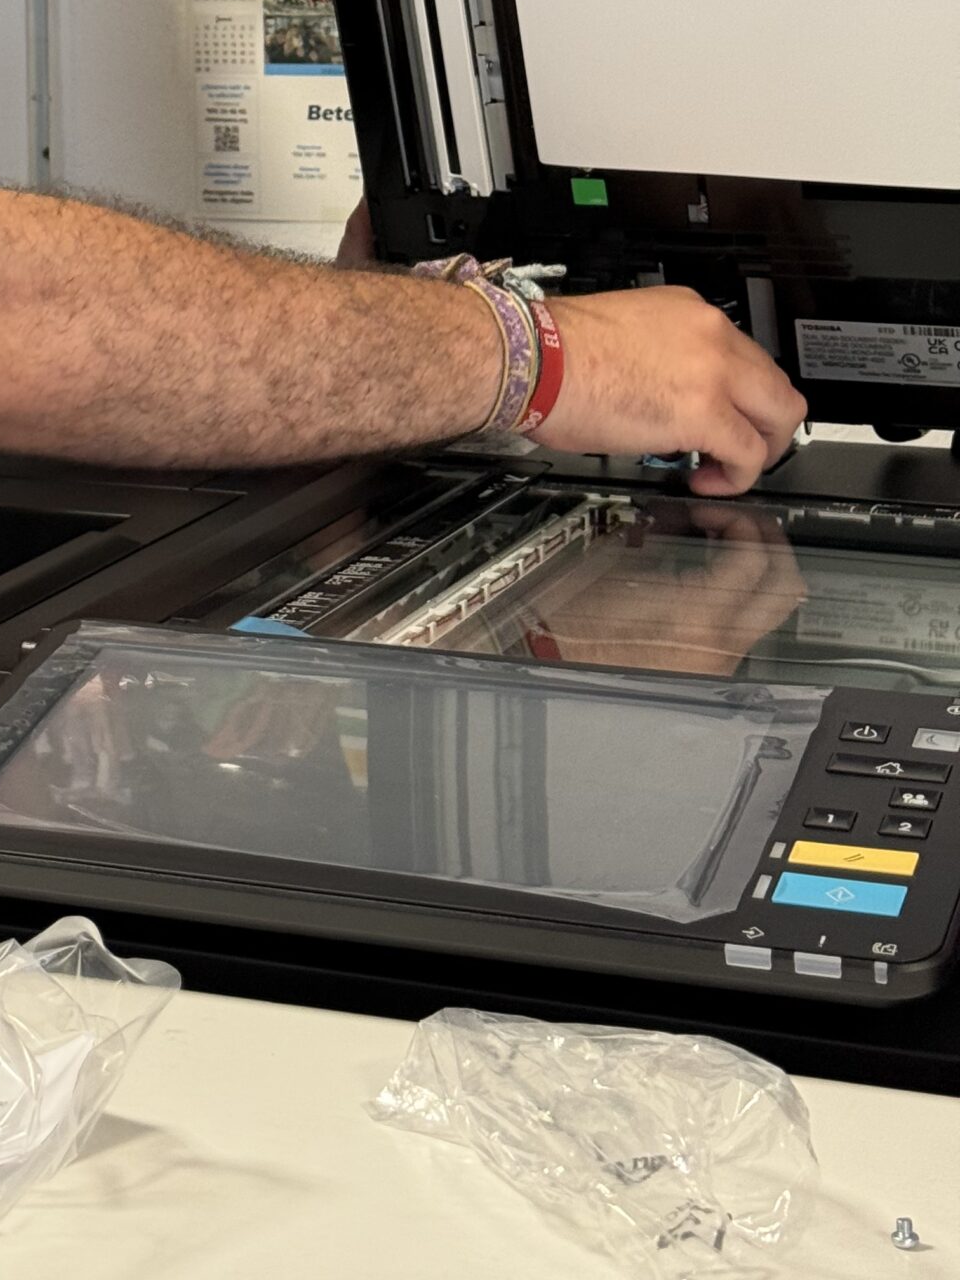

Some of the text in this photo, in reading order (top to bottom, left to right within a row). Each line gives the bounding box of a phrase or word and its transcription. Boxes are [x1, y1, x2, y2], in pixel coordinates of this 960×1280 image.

[927, 338, 948, 347] UK
[928, 346, 949, 355] CA
[824, 813, 835, 824] 1
[898, 821, 912, 833] 2
